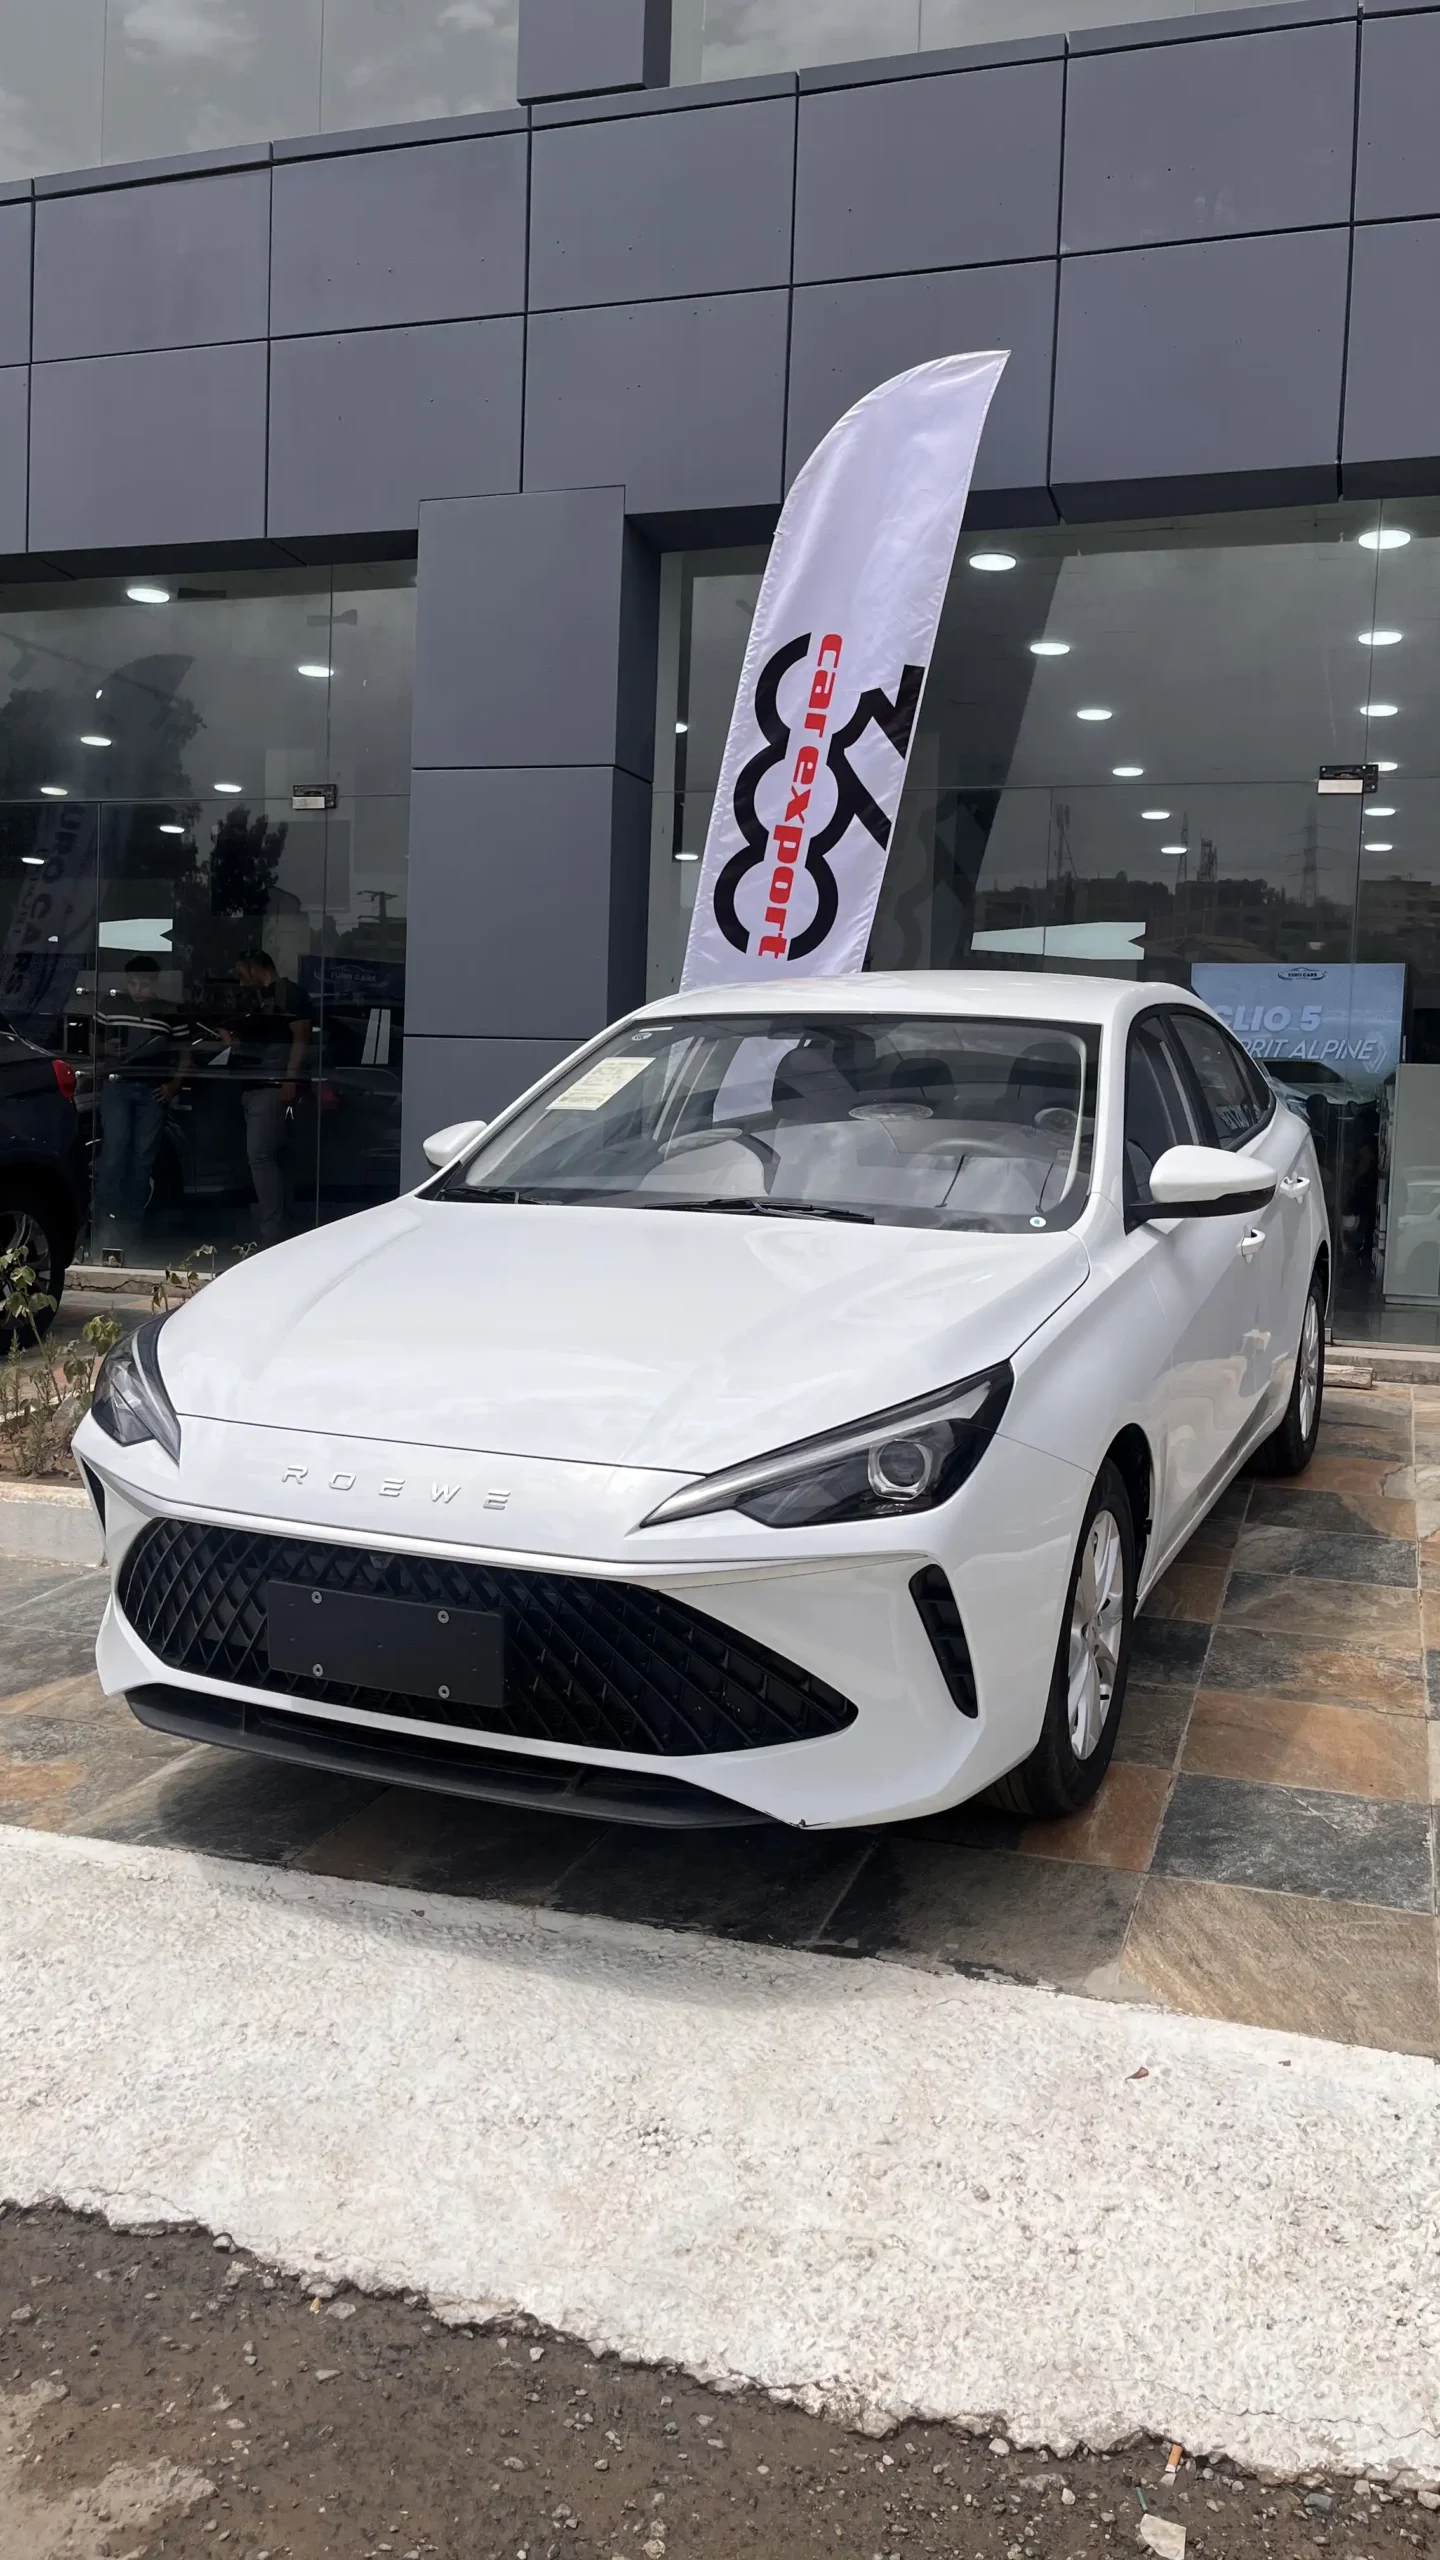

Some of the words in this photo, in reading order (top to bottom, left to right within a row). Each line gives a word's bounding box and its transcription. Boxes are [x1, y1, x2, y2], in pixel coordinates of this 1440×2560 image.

[804, 633, 843, 738] car
[758, 745, 819, 960] export
[1300, 1005, 1322, 1032] 5
[1288, 1039, 1378, 1060] ALPINE
[281, 1464, 511, 1511] ROEWE
